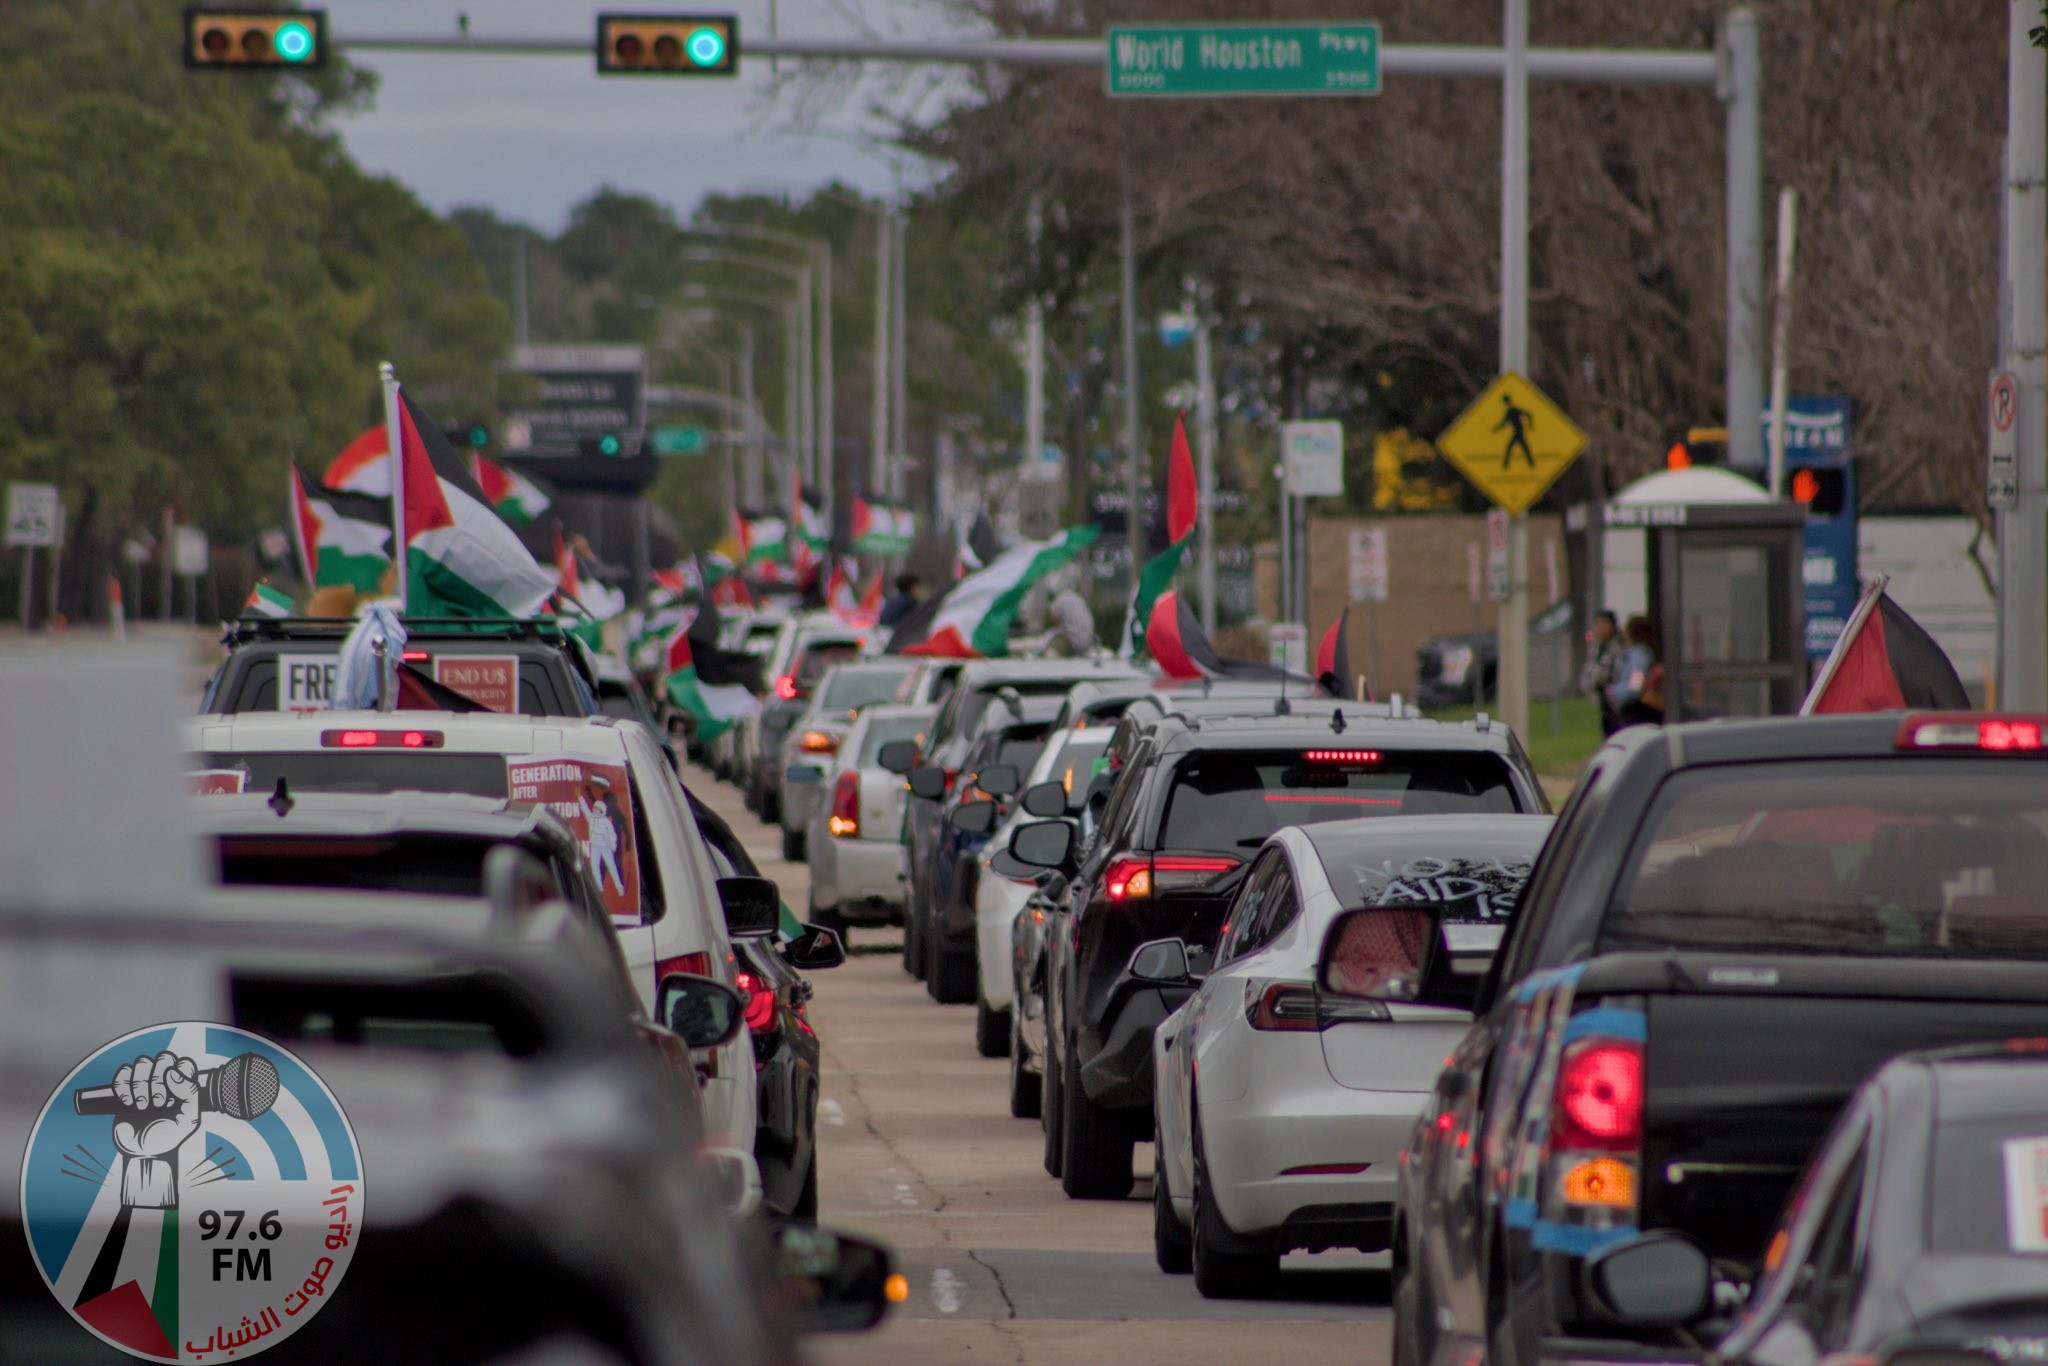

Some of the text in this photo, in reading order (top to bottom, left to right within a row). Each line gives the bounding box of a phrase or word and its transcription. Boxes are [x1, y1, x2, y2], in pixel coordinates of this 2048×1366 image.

[1117, 34, 1184, 71] World
[1200, 34, 1302, 70] Houston
[290, 663, 337, 701] FRE
[443, 668, 480, 685] END
[511, 764, 583, 784] GENERATION
[512, 786, 538, 800] AFTER
[1350, 857, 1448, 883] NO
[1375, 875, 1488, 907] AID
